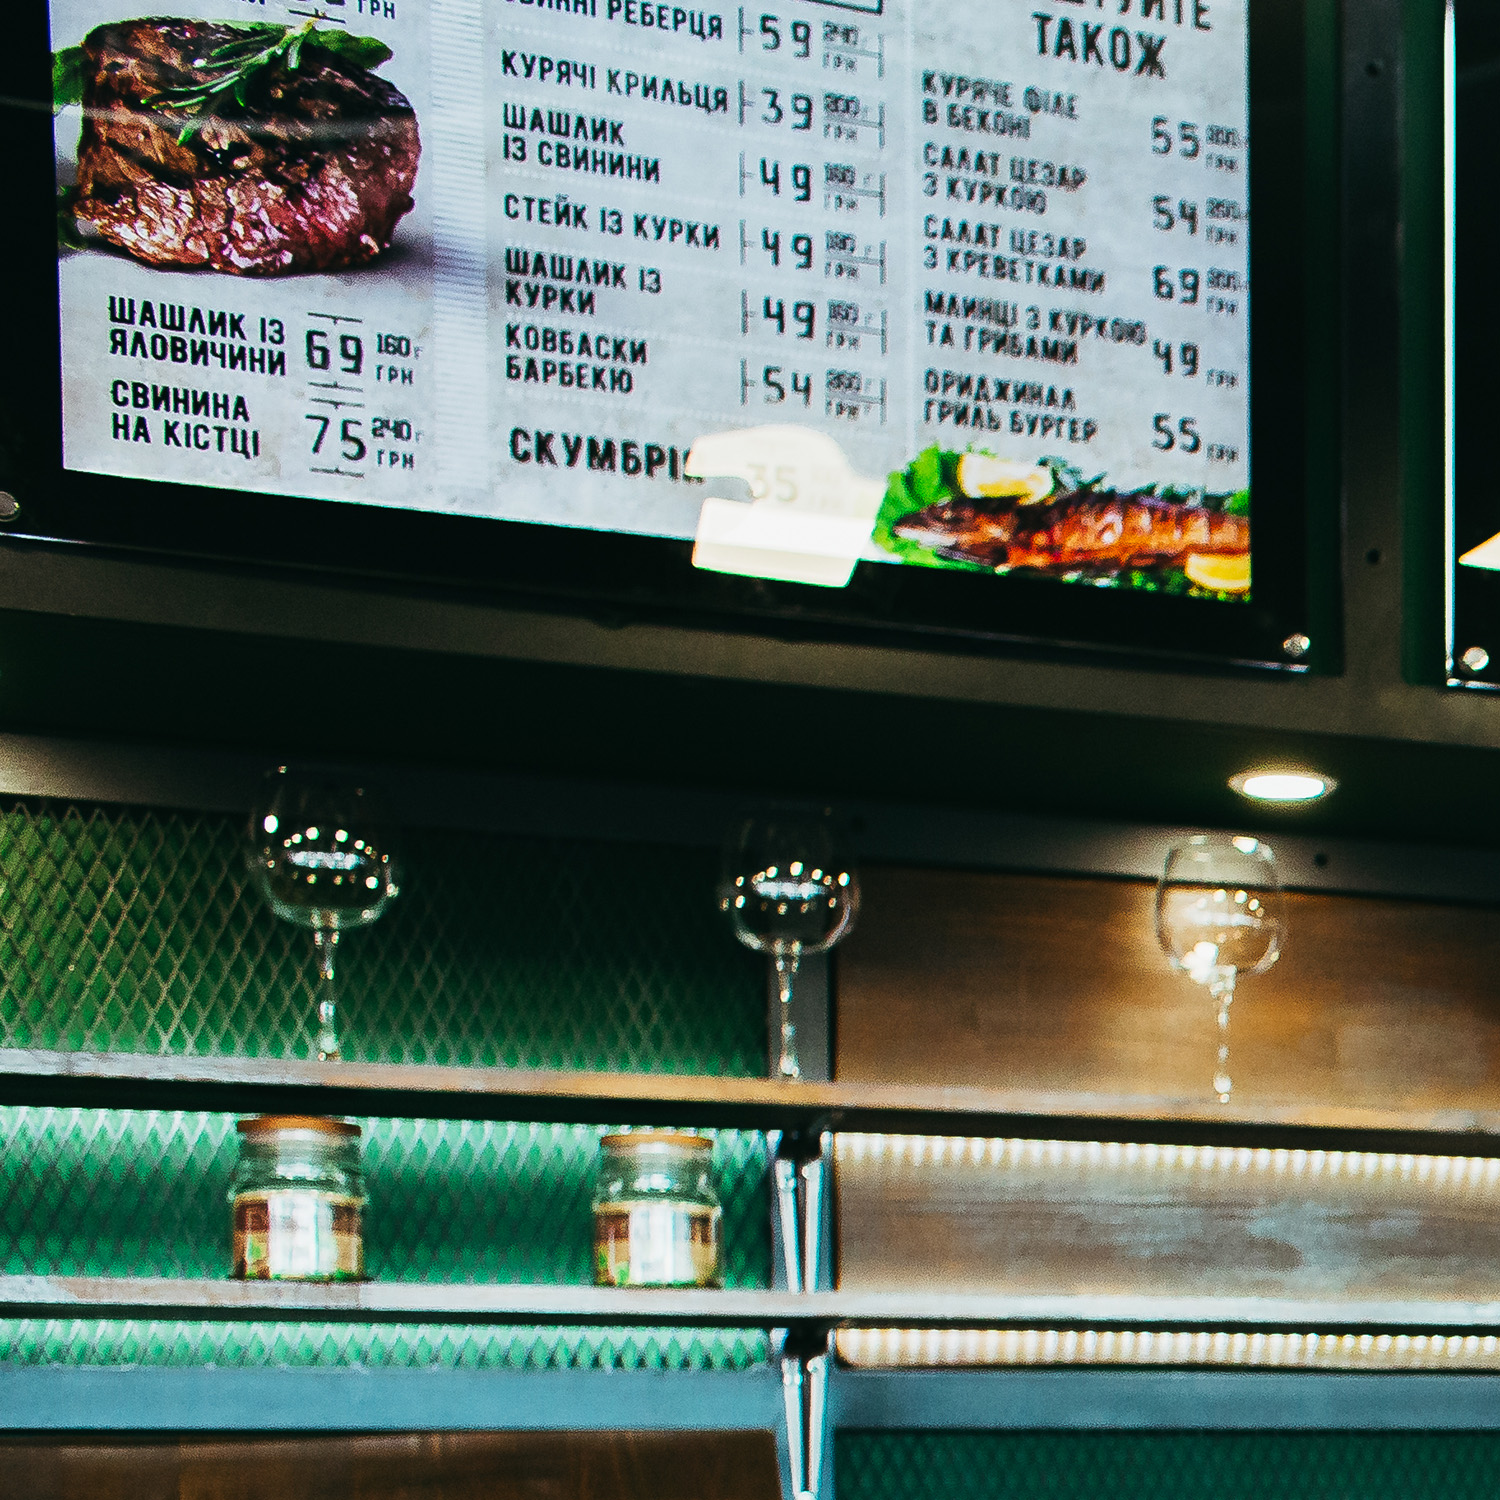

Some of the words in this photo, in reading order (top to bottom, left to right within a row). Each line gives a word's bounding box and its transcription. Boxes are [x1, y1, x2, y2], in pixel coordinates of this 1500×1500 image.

[606, 0, 722, 40] РЕБЕРЦЯ
[759, 13, 810, 57] 59
[1031, 11, 1164, 77] ТАКОЖ
[500, 49, 595, 88] КУРЯЧІ
[606, 68, 727, 113] КРИЛЬЦЯ
[502, 102, 624, 145] ШАШЛИК
[762, 87, 812, 130] 39
[502, 132, 526, 161] ІЗ
[537, 139, 659, 182] СВИНИНИ
[1151, 115, 1199, 158] 55
[759, 157, 810, 201] 49
[923, 141, 999, 175] САЛАТ
[1009, 157, 1085, 190] ЦЕЗАР
[503, 192, 587, 228] СТЕЙК
[599, 207, 622, 235] ІЗ
[632, 213, 718, 248] КУРКИ
[1151, 194, 1197, 234] 54
[761, 227, 812, 269] 49
[923, 214, 999, 247] САЛАТ
[1009, 229, 1085, 260] ЦЕЗАР
[503, 247, 625, 287] ШАШЛИК
[638, 267, 661, 293] ІЗ
[946, 248, 1104, 291] КРЕВЕТКАМИ
[1152, 264, 1199, 303] 69
[505, 279, 594, 314] КУРКИ
[762, 296, 814, 338] 49
[108, 295, 245, 339] ШАШЛИК
[259, 316, 284, 345] ІЗ
[926, 320, 952, 344] ТА
[964, 325, 1076, 362] ГРИБАМИ
[109, 327, 285, 375] ЯЛОВИЧИНИ
[304, 328, 363, 374] 69
[376, 332, 410, 356] 160
[504, 323, 646, 363] КОВБАСКИ
[1152, 339, 1197, 376] 49
[375, 364, 412, 384] ГРН
[505, 354, 632, 393] БАРБЕКЮ
[762, 365, 811, 404] 54
[110, 379, 249, 422] СВИНИНА
[923, 398, 1000, 430] ГРИЛЬ
[1009, 409, 1096, 441] БУРГЕР
[111, 412, 150, 443] НА
[163, 419, 259, 459] КІСТЦІ
[304, 413, 366, 461] 75
[370, 416, 411, 441] 240
[1152, 413, 1200, 453] 55
[376, 448, 413, 468] ГРН
[509, 427, 705, 484] СКУМБРІ
